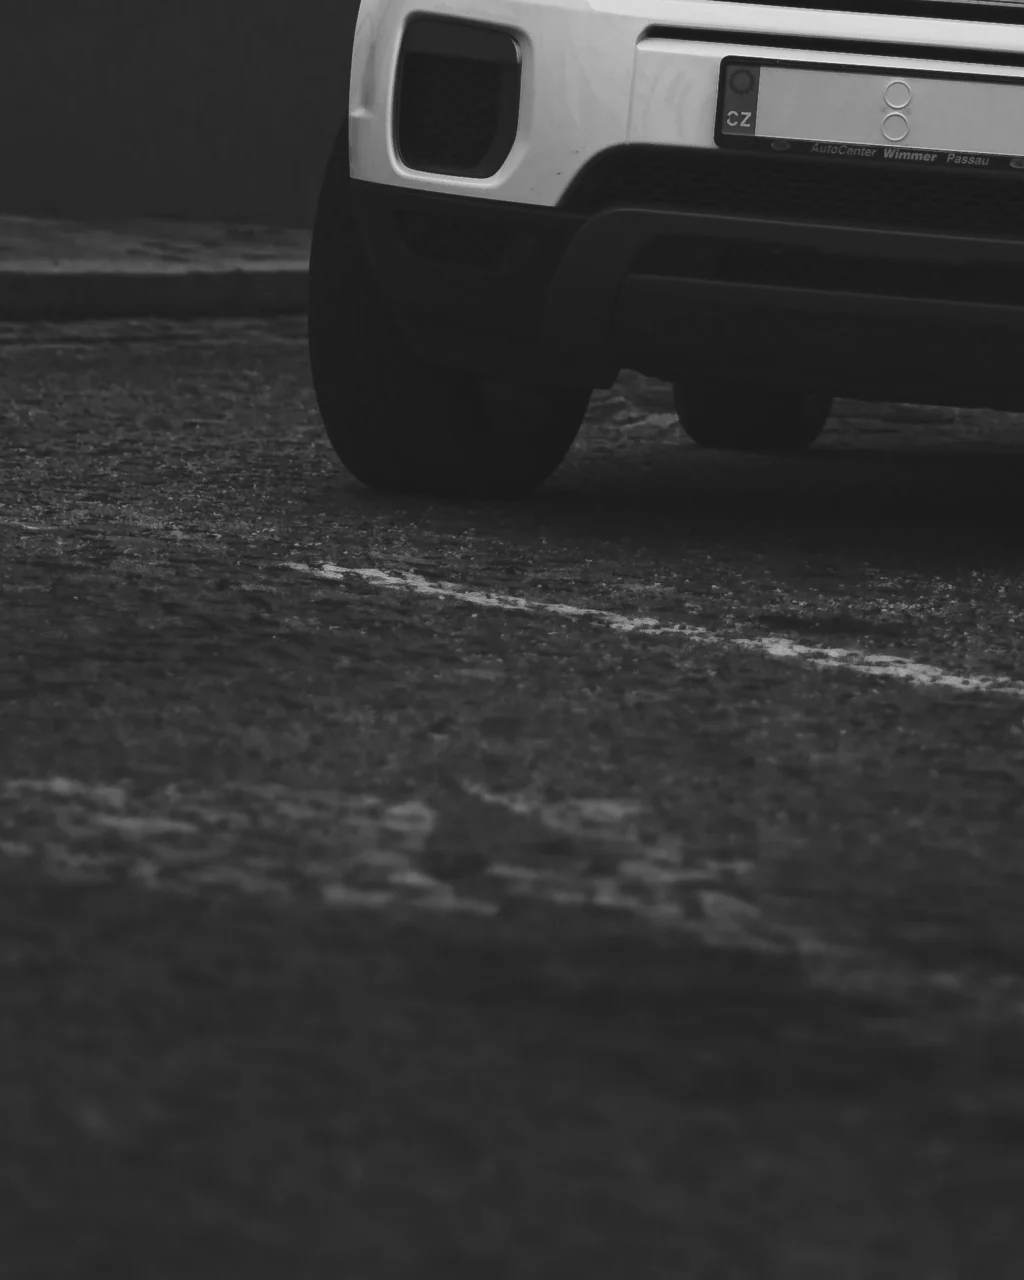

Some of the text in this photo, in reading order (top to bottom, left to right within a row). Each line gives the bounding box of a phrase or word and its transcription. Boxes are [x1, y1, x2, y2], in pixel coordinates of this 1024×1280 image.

[726, 110, 752, 129] CZ
[810, 142, 990, 167] AutoCenter Wimmer Passau
